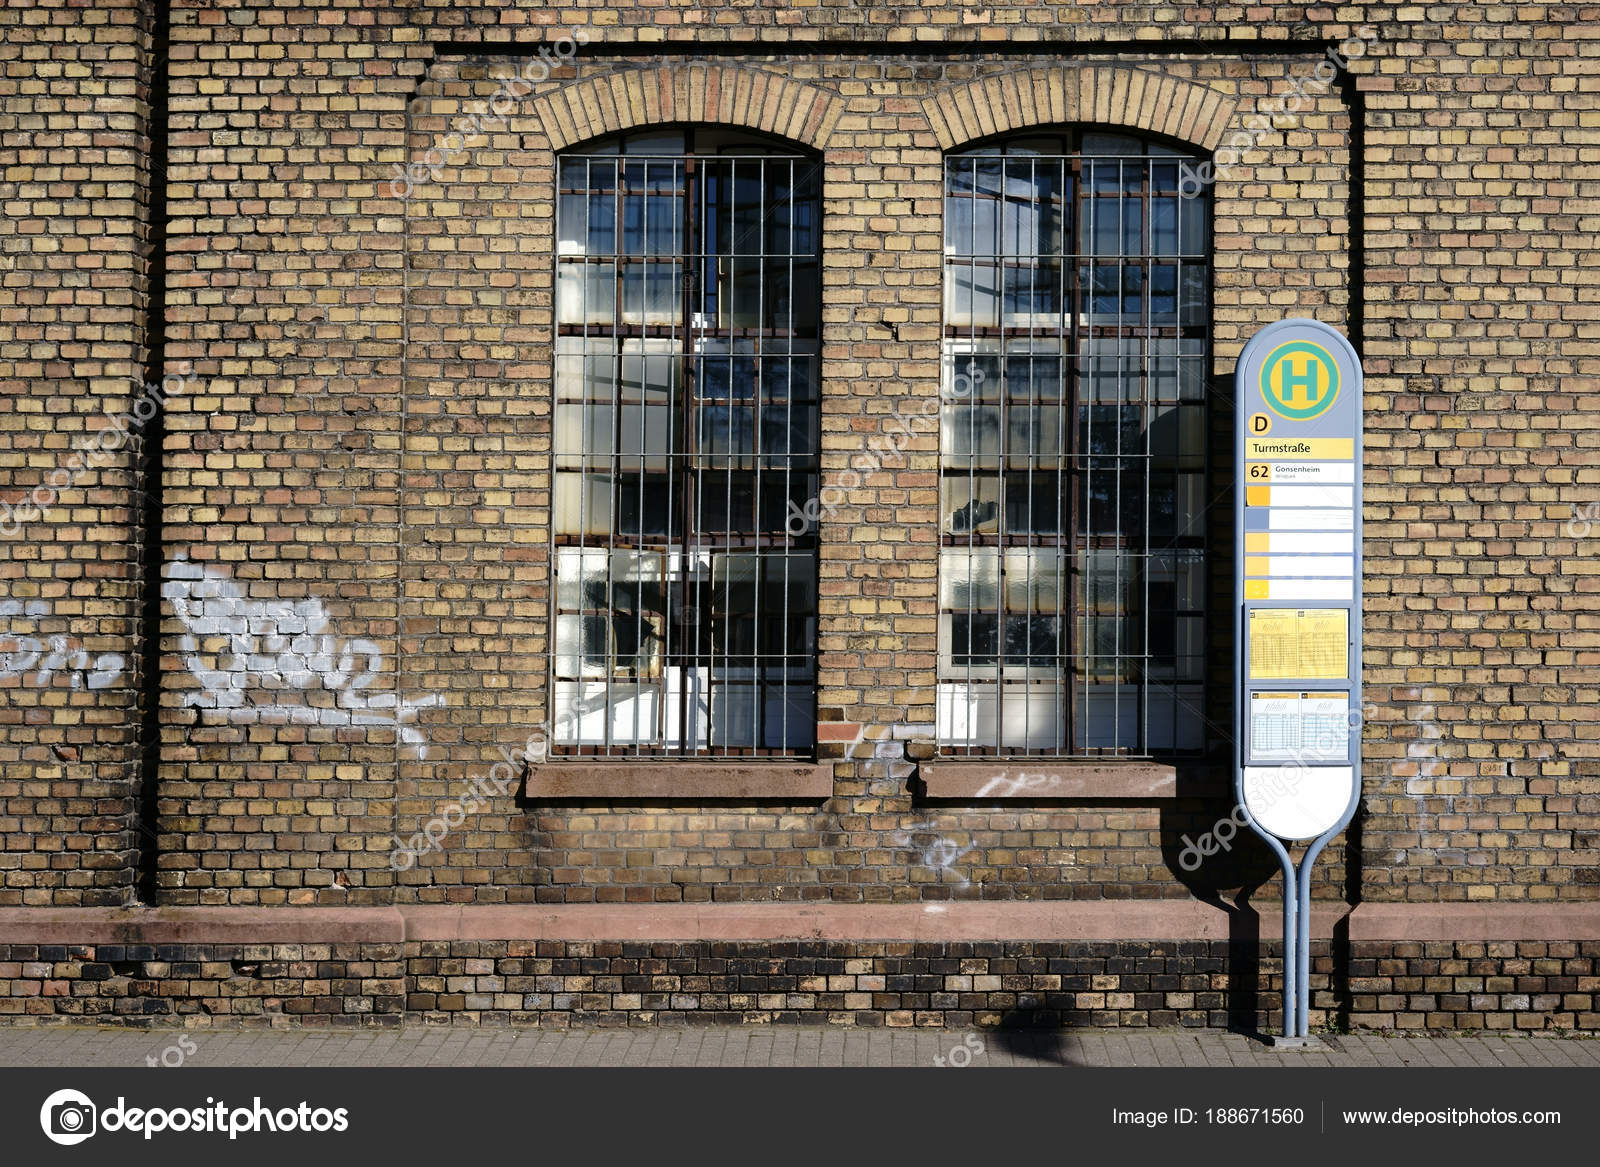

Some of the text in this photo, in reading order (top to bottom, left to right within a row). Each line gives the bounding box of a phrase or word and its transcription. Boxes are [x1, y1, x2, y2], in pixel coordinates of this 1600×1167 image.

[1281, 360, 1318, 401] H
[1254, 416, 1268, 431] D
[1252, 442, 1311, 453] Turmstraße
[1250, 465, 1269, 478] 62
[1275, 465, 1321, 473] Gonsenheim
